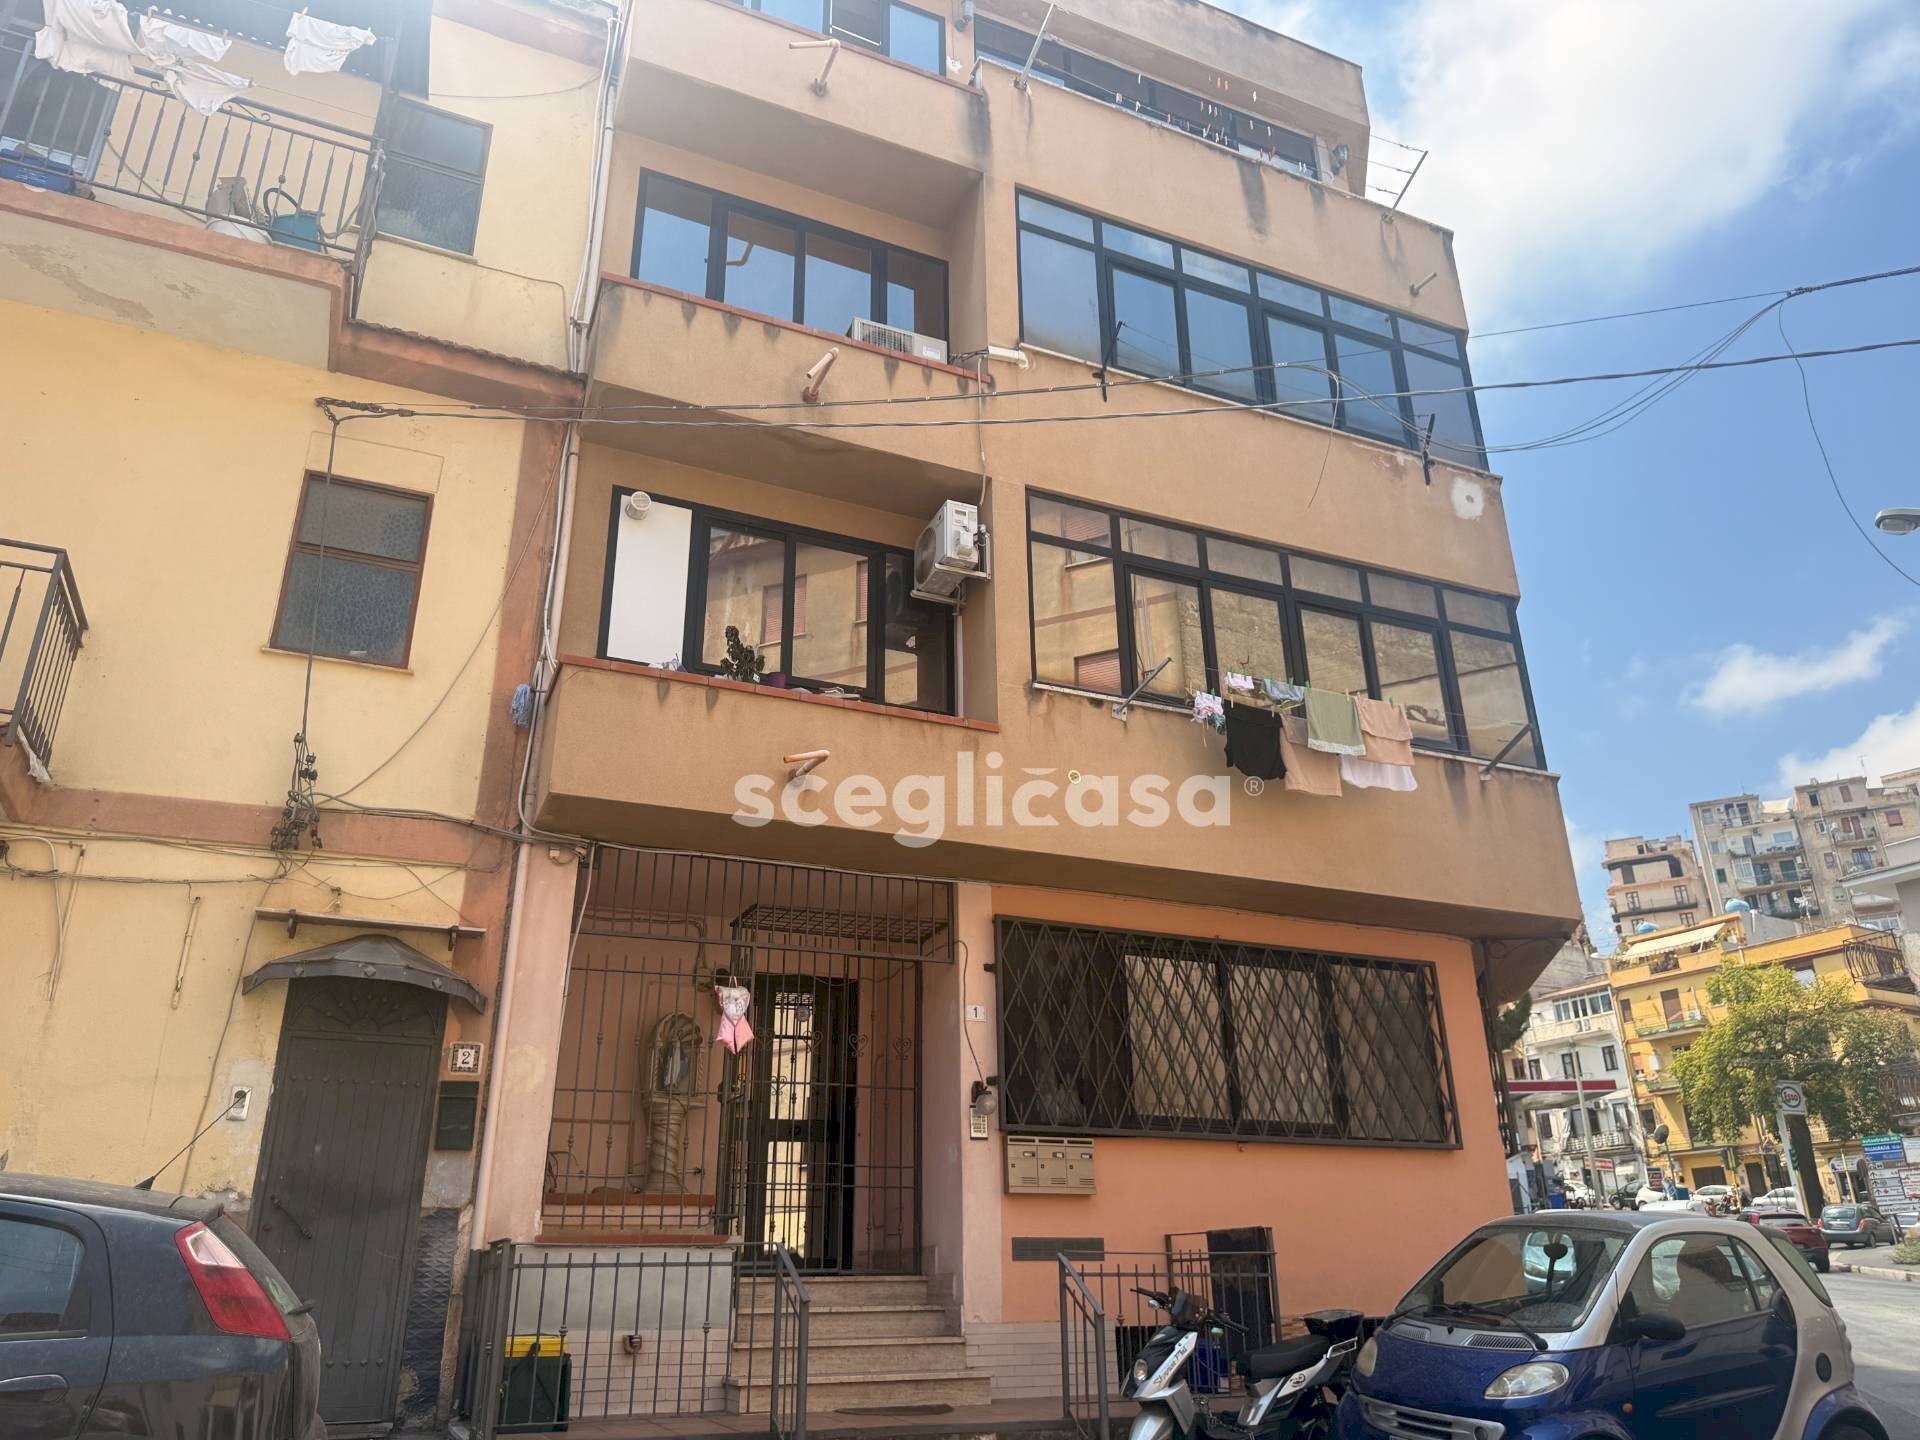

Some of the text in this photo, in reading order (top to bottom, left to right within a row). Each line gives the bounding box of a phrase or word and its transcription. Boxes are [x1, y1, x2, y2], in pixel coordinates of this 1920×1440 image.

[973, 1007, 978, 1018] 1
[461, 1051, 471, 1065] 2
[1783, 1091, 1799, 1102] Esso
